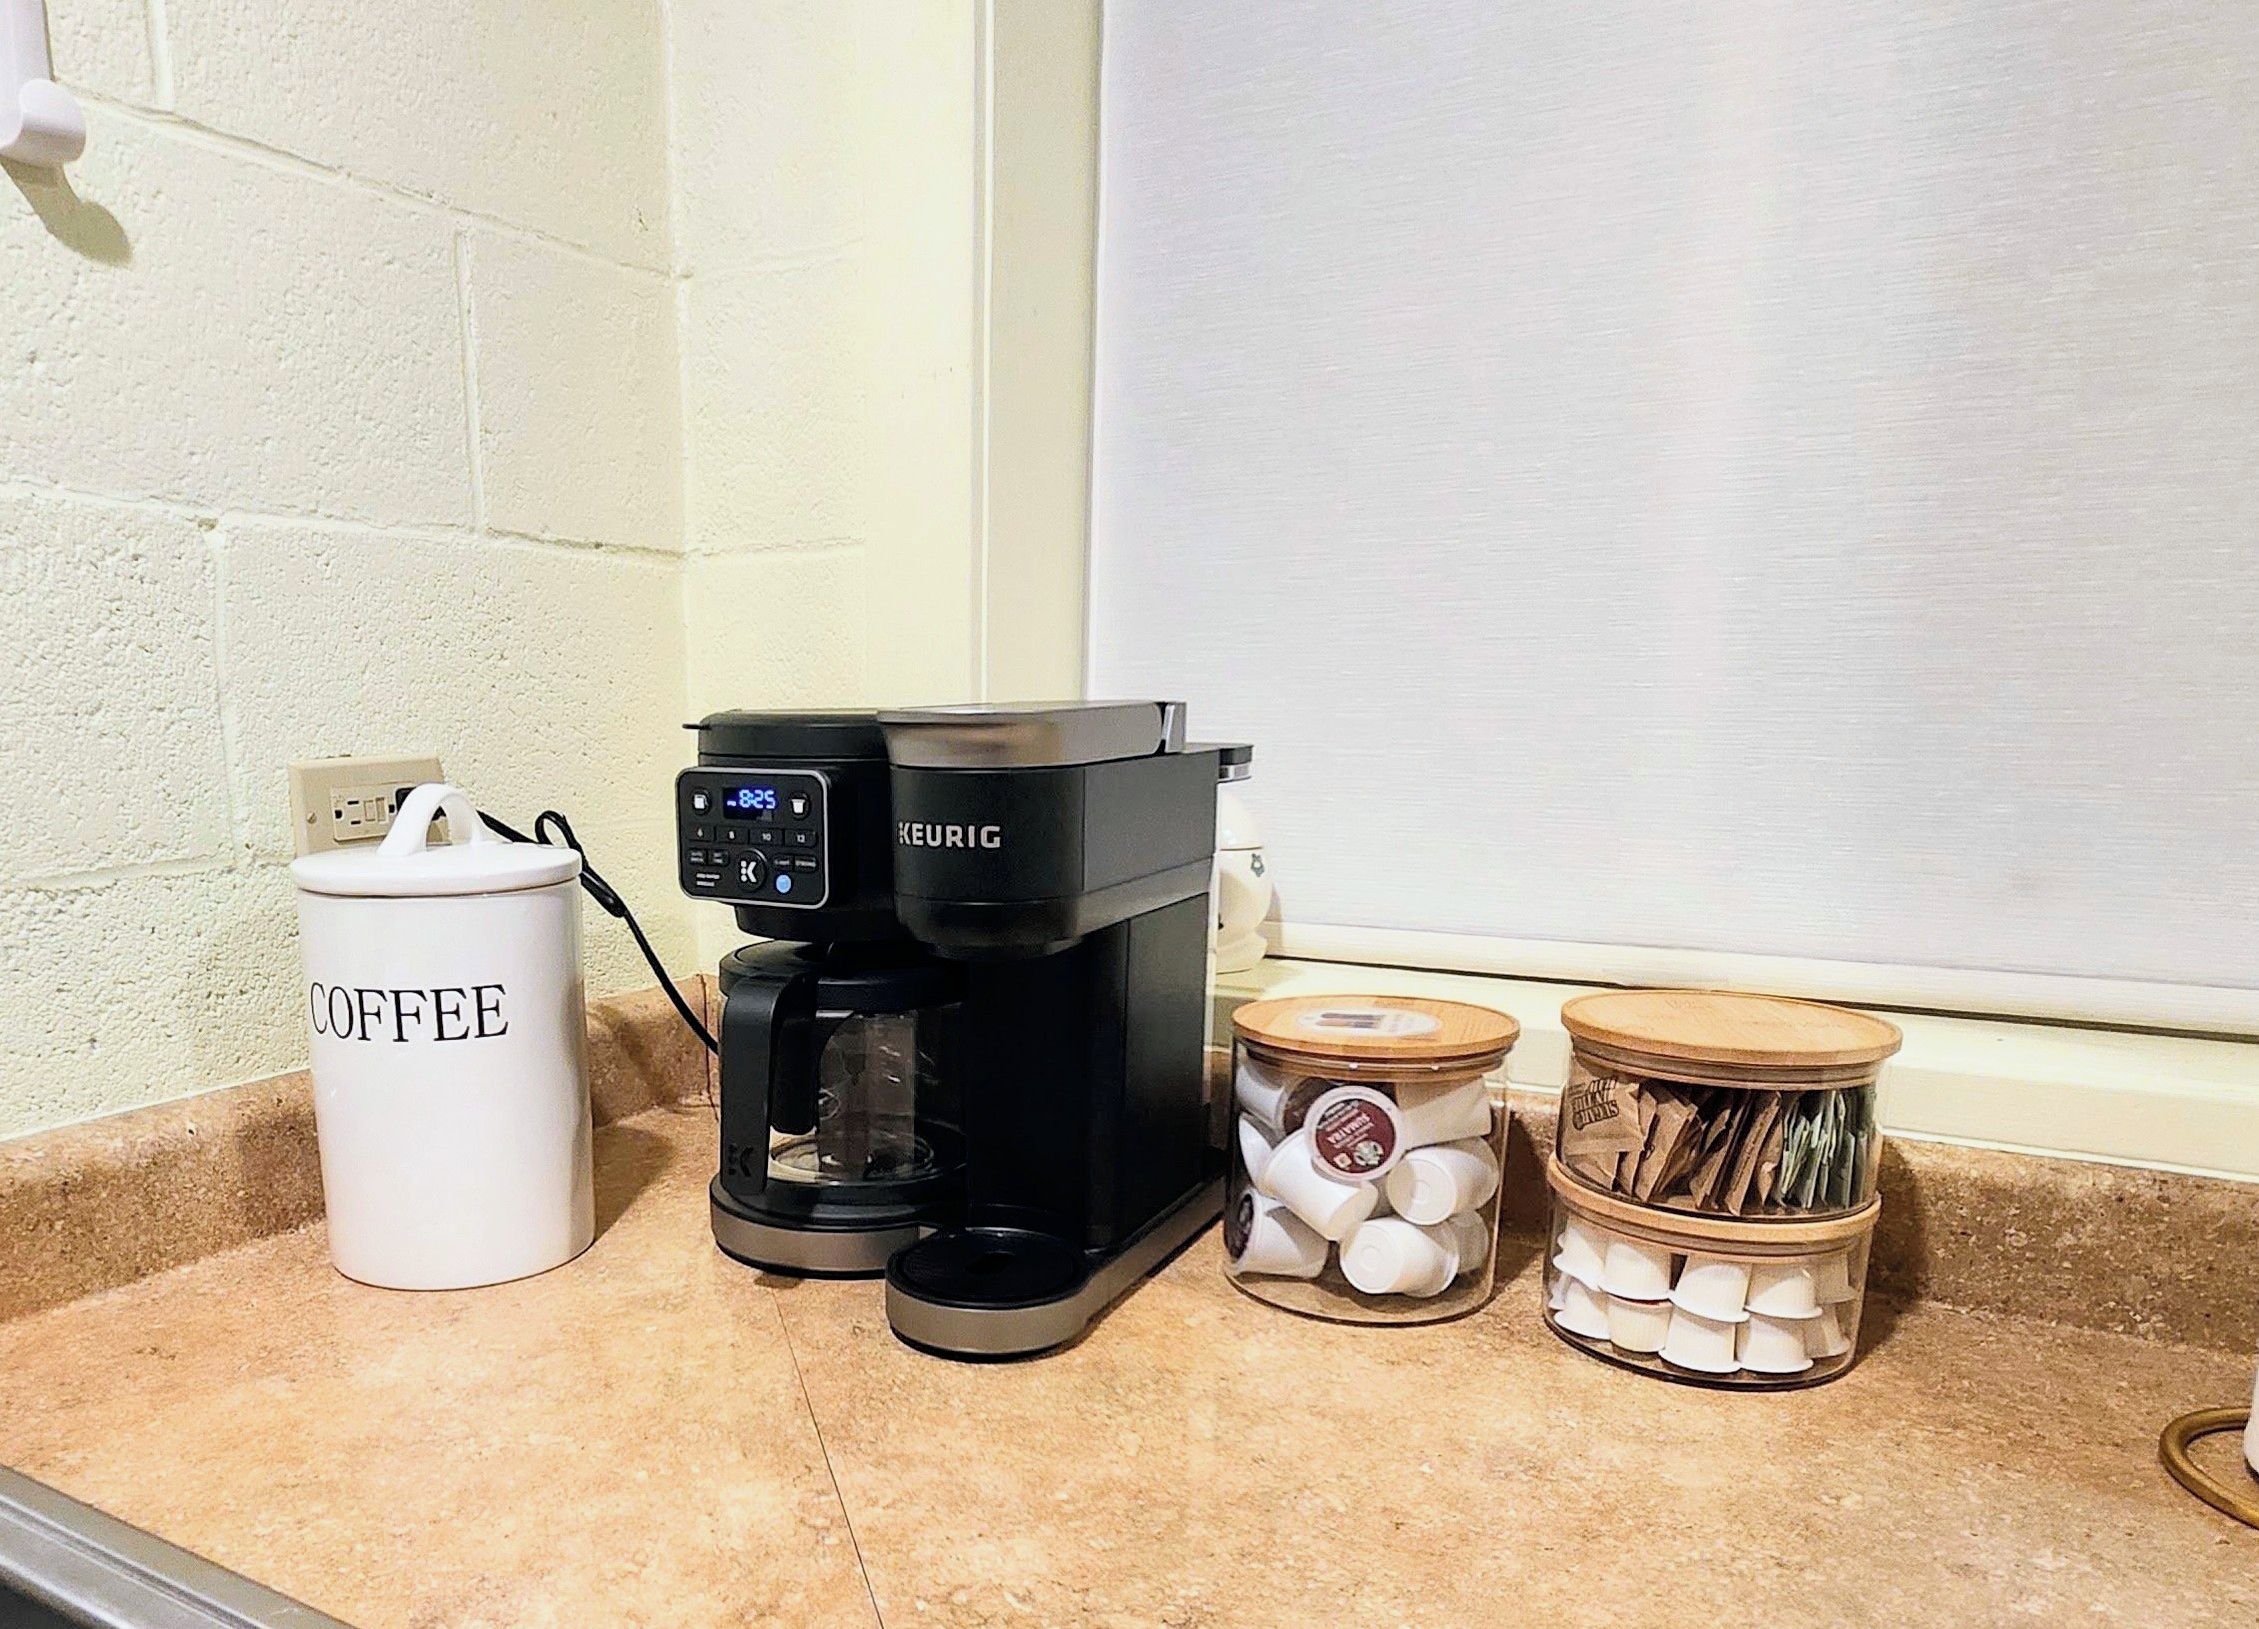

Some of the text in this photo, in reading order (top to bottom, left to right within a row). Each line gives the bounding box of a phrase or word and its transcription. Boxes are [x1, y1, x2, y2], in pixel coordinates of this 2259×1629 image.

[739, 789, 776, 809] 8:25
[898, 821, 1001, 849] KEURIG
[310, 981, 509, 1043] COFFEE
